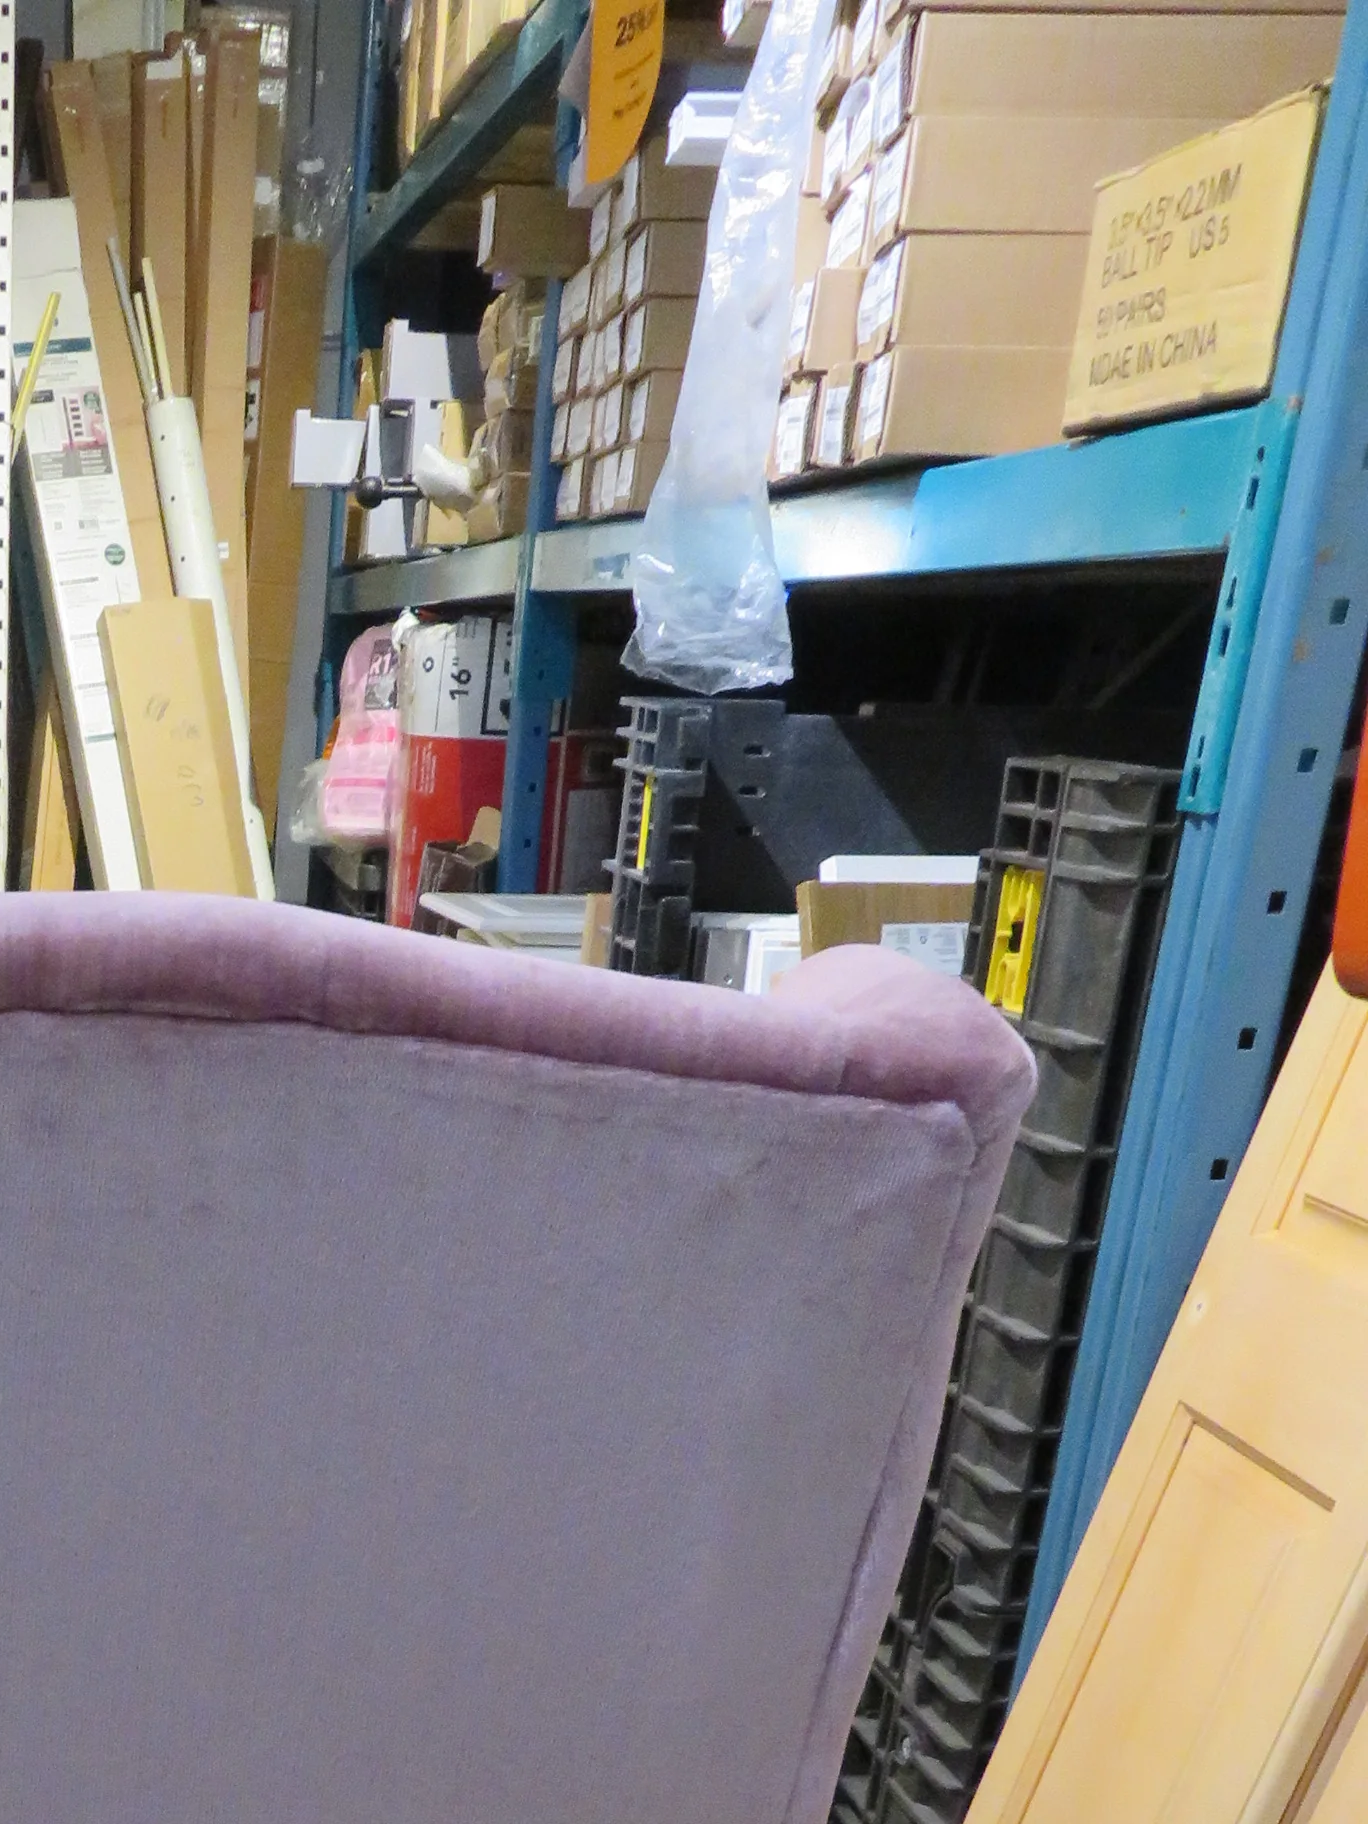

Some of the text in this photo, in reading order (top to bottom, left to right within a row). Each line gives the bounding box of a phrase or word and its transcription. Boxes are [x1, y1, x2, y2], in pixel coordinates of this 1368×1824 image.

[1101, 249, 1137, 289] BALL
[1146, 231, 1173, 270] TIP
[1136, 339, 1156, 374] IN
[1160, 320, 1217, 368] CHINA
